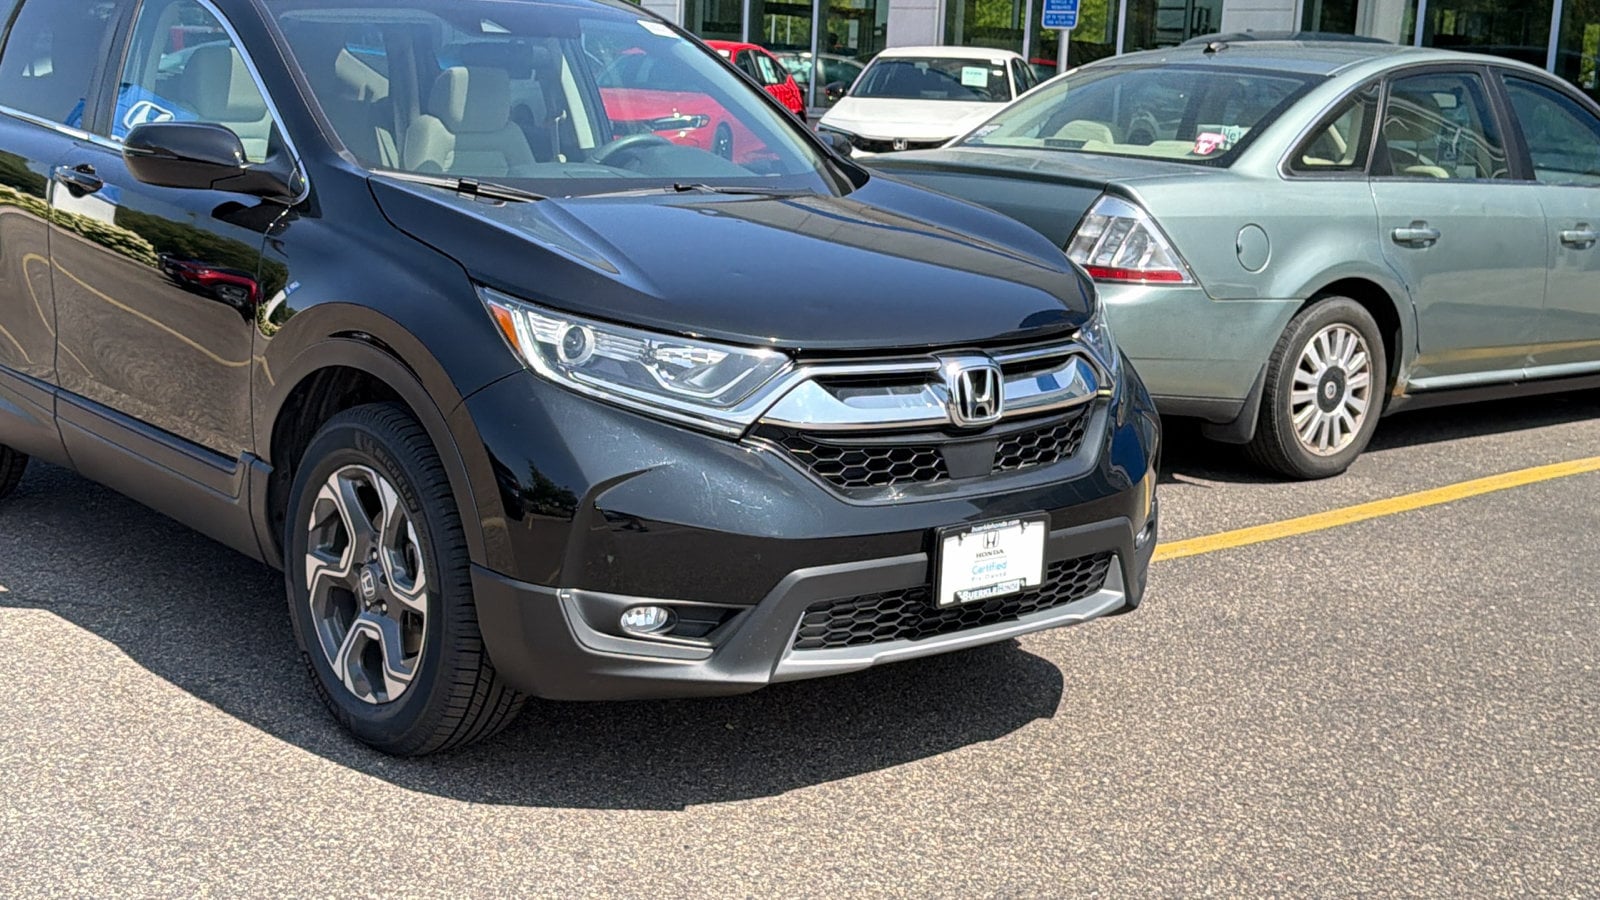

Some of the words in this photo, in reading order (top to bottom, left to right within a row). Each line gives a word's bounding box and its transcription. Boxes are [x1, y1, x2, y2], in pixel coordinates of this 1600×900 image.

[374, 447, 418, 512] MICHELIN
[976, 549, 1004, 558] HONDA
[972, 560, 1007, 575] Certified
